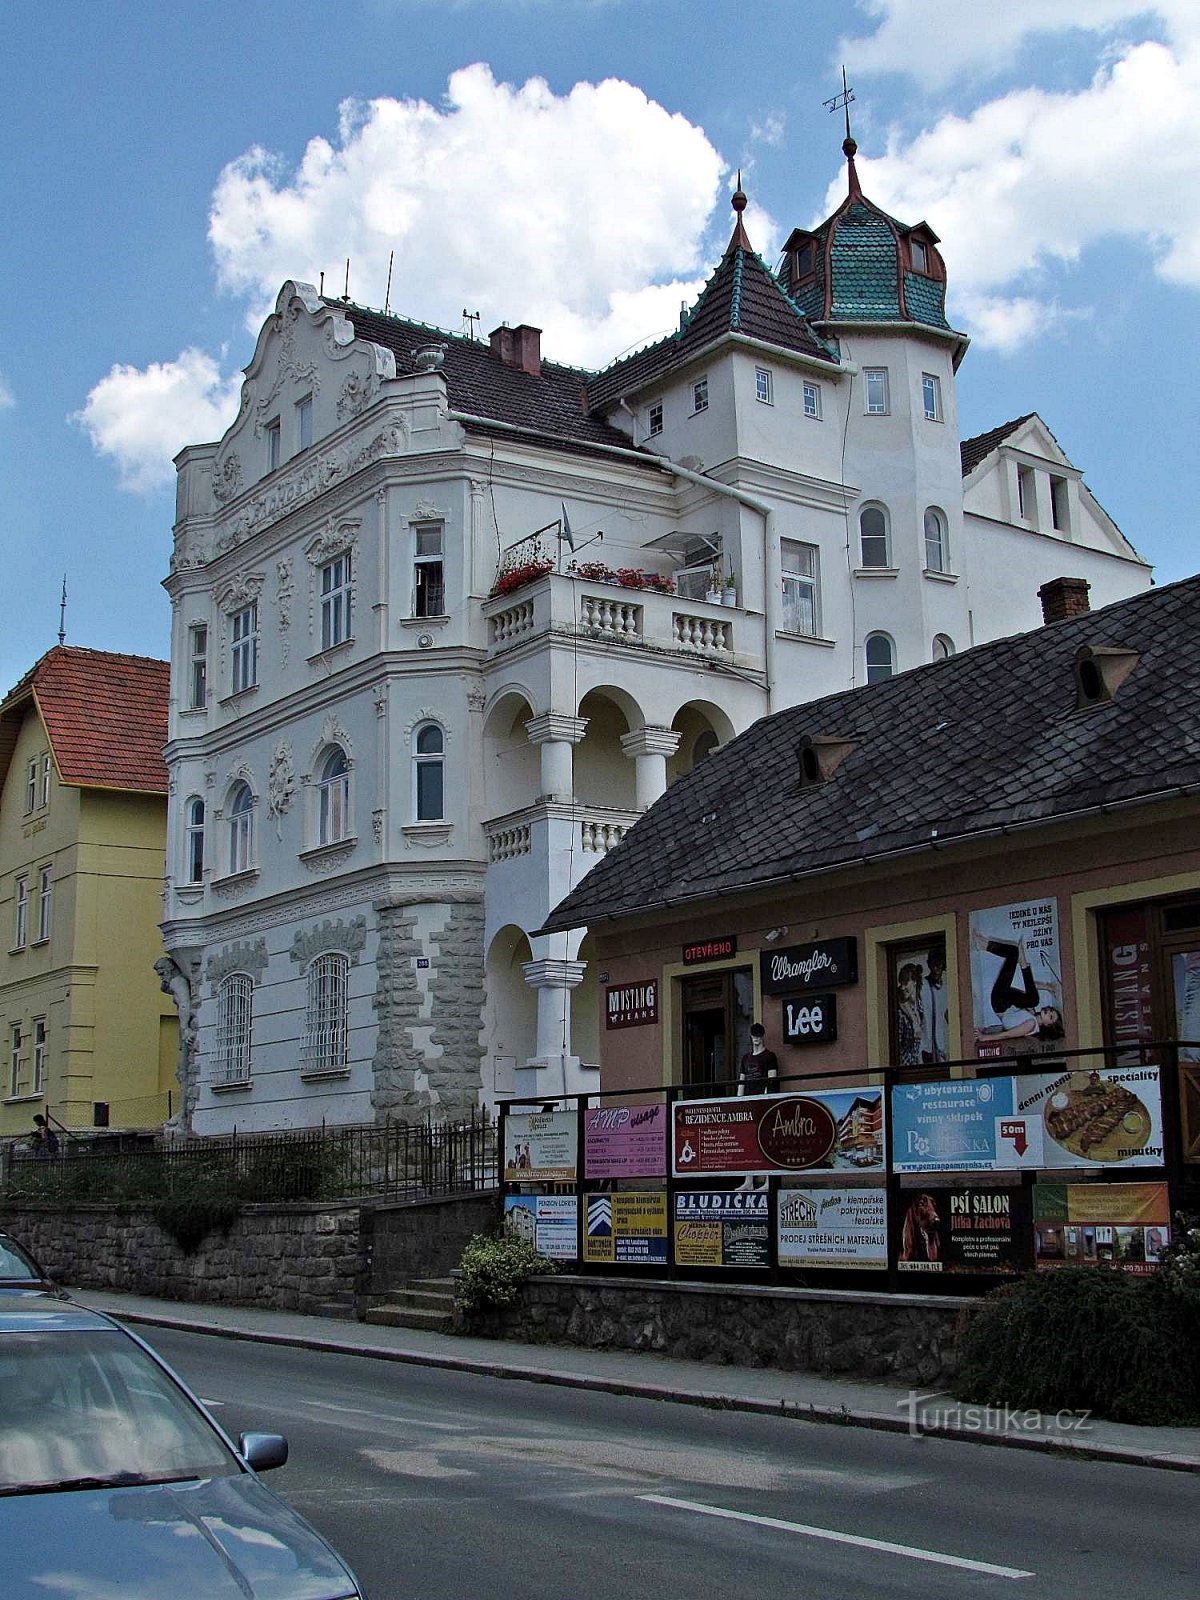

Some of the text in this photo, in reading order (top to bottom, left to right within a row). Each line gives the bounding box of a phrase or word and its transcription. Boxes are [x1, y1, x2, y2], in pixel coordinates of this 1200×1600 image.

[1012, 921, 1021, 929] TY
[684, 940, 732, 961] OTEVŘENO
[1026, 940, 1039, 949] PRO
[771, 949, 833, 983] Wrangler
[608, 985, 655, 1013] MUSTANG
[620, 1009, 655, 1022] JEANS
[786, 1004, 823, 1036] Lee
[1045, 1071, 1074, 1095] menu
[1108, 1071, 1159, 1083] speciality
[922, 1099, 977, 1110] restaurace
[685, 1111, 754, 1125] REZIDENCE AMBRA
[772, 1103, 818, 1139] Ambra
[1002, 1126, 1024, 1135] 50m
[1118, 1147, 1163, 1158] minutky
[676, 1192, 768, 1209] BLUDIČKA
[950, 1190, 1010, 1214] PSÍ SALON
[950, 1214, 1011, 1232] Jitka Zachová
[678, 1223, 719, 1242] Chopper
[781, 1232, 885, 1245] PRODEJ STŘEŠNÍCH MATERIÁLŮ
